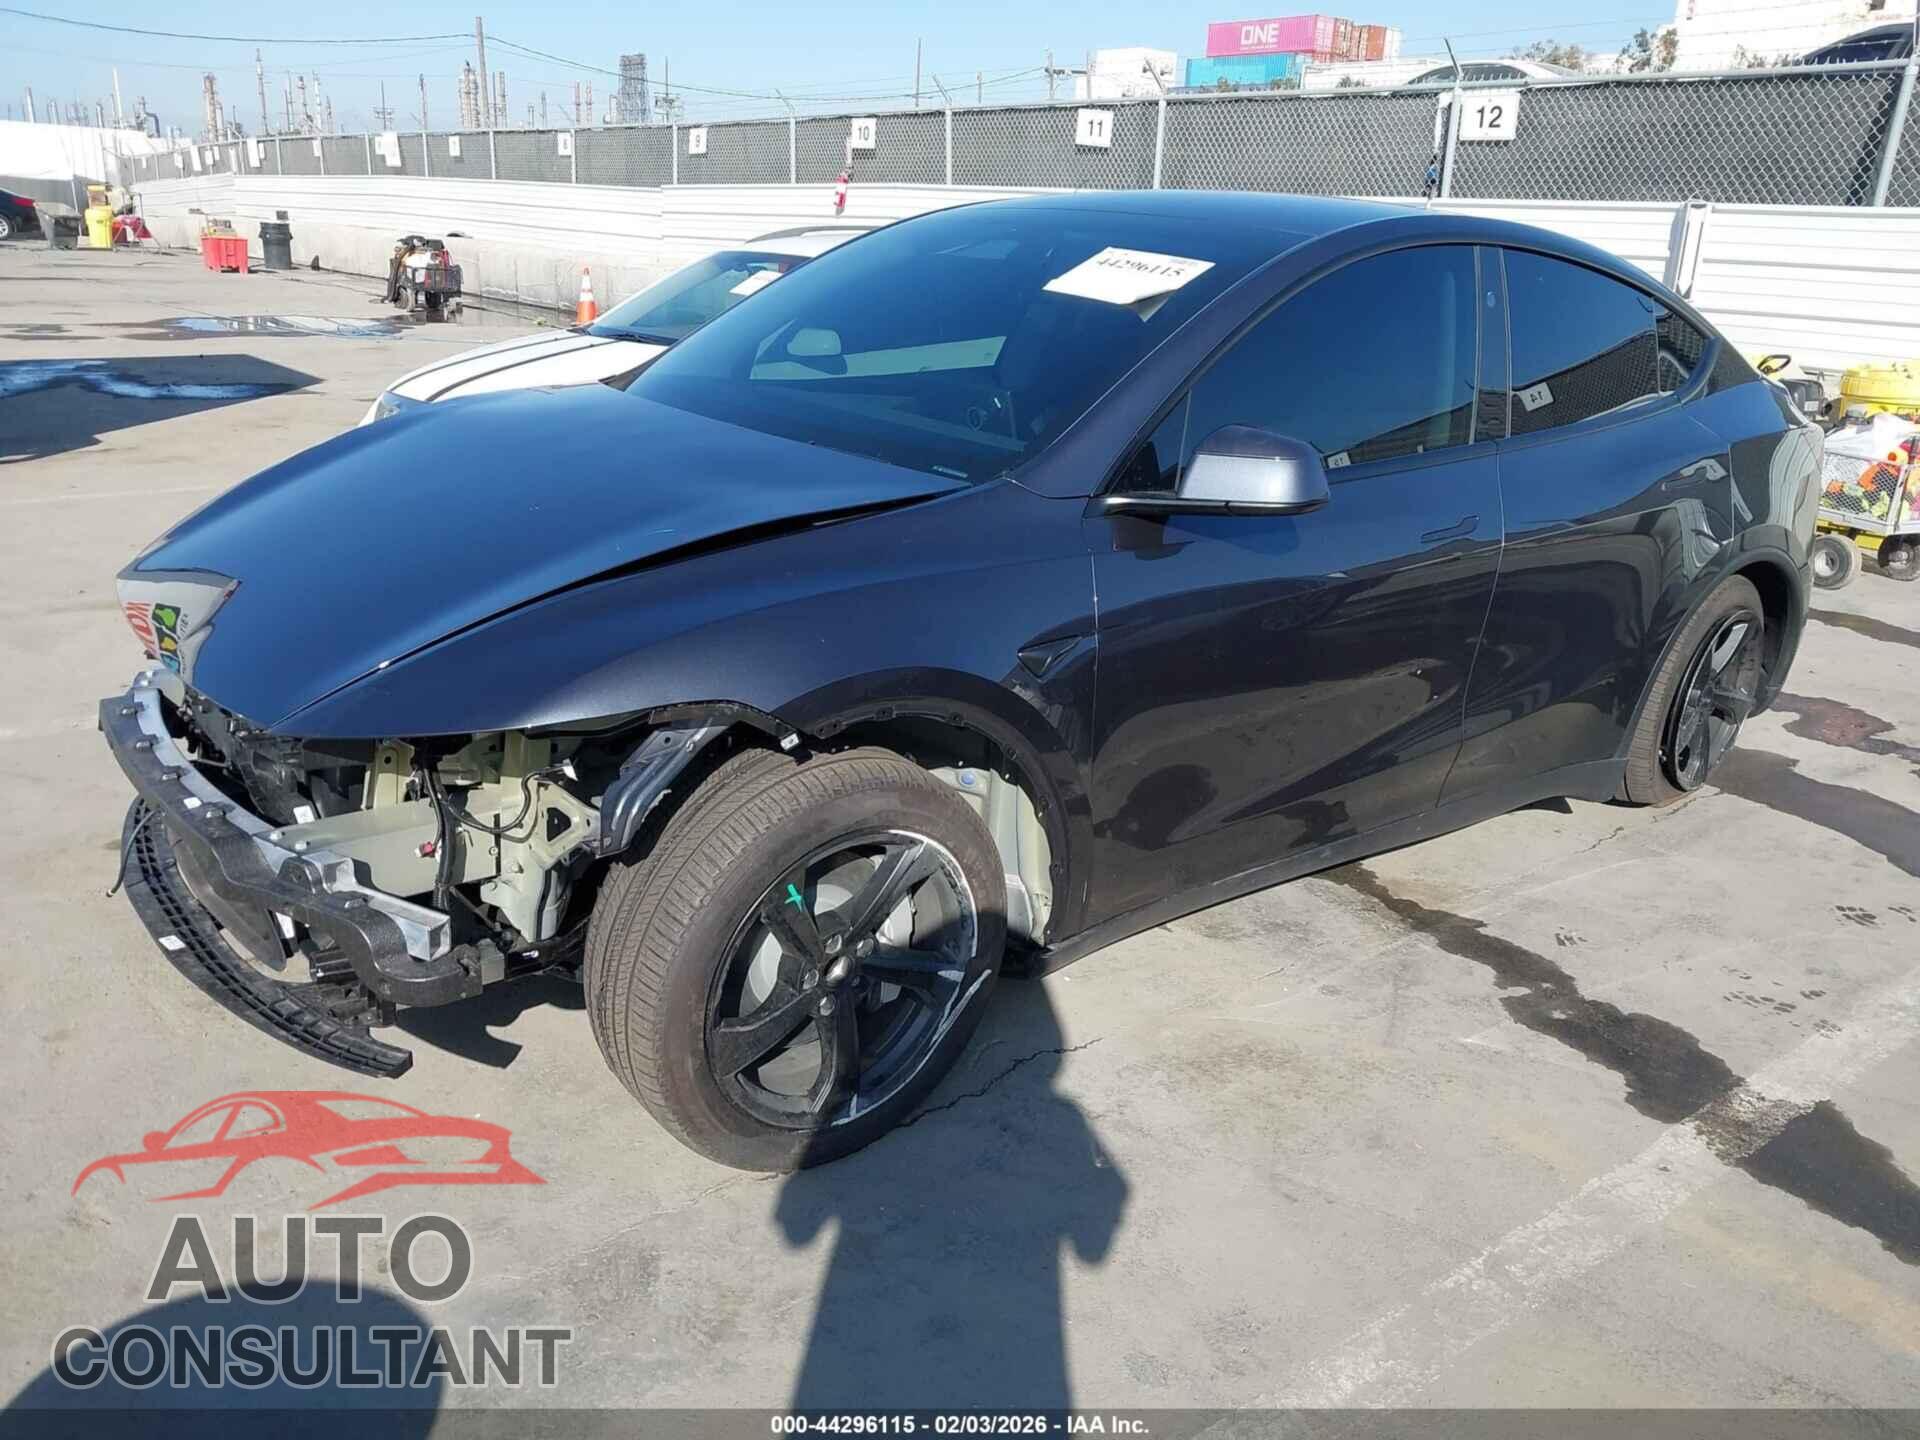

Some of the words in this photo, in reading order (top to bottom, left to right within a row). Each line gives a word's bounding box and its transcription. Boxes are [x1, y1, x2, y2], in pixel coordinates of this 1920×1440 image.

[1240, 23, 1279, 45] ONE
[1476, 105, 1503, 128] 12
[857, 125, 870, 141] 10
[1087, 119, 1104, 137] 11
[695, 134, 701, 148] 9
